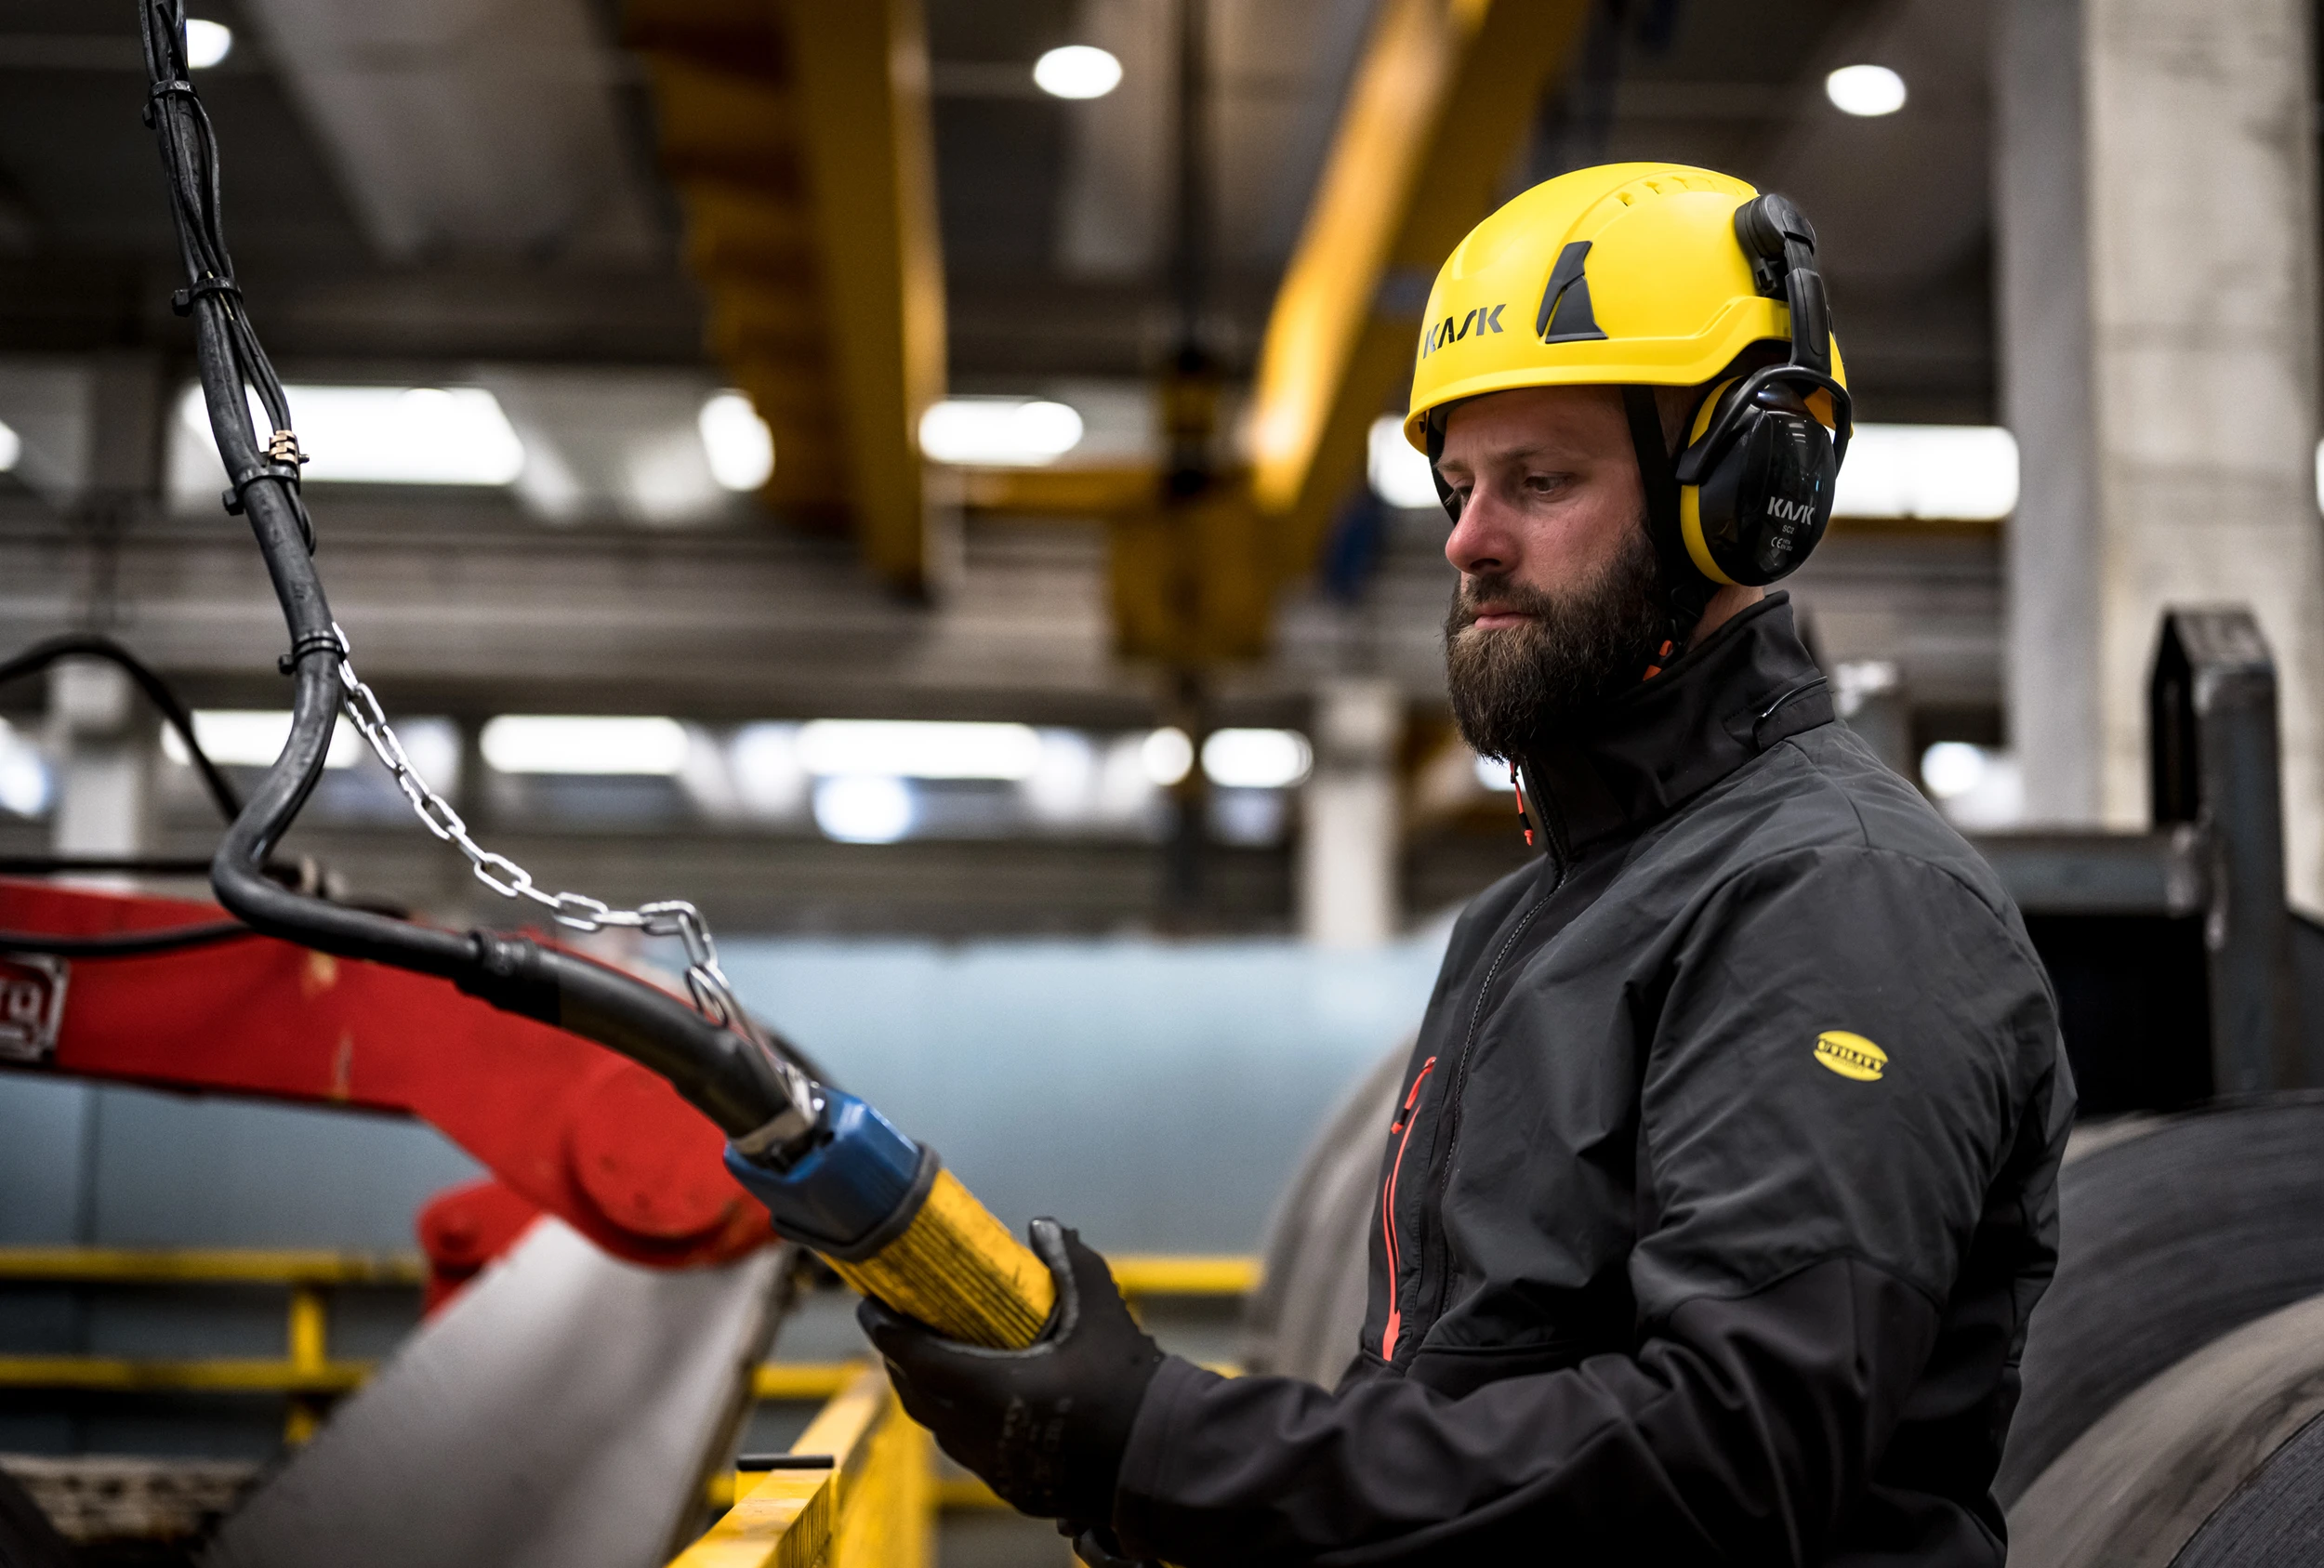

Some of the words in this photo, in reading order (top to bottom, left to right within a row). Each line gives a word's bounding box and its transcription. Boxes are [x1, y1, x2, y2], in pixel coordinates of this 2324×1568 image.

[1423, 303, 1507, 359] KASK
[1767, 496, 1816, 526] KASK
[1782, 524, 1795, 534] SC2
[1816, 1038, 1885, 1073] UTILITY
